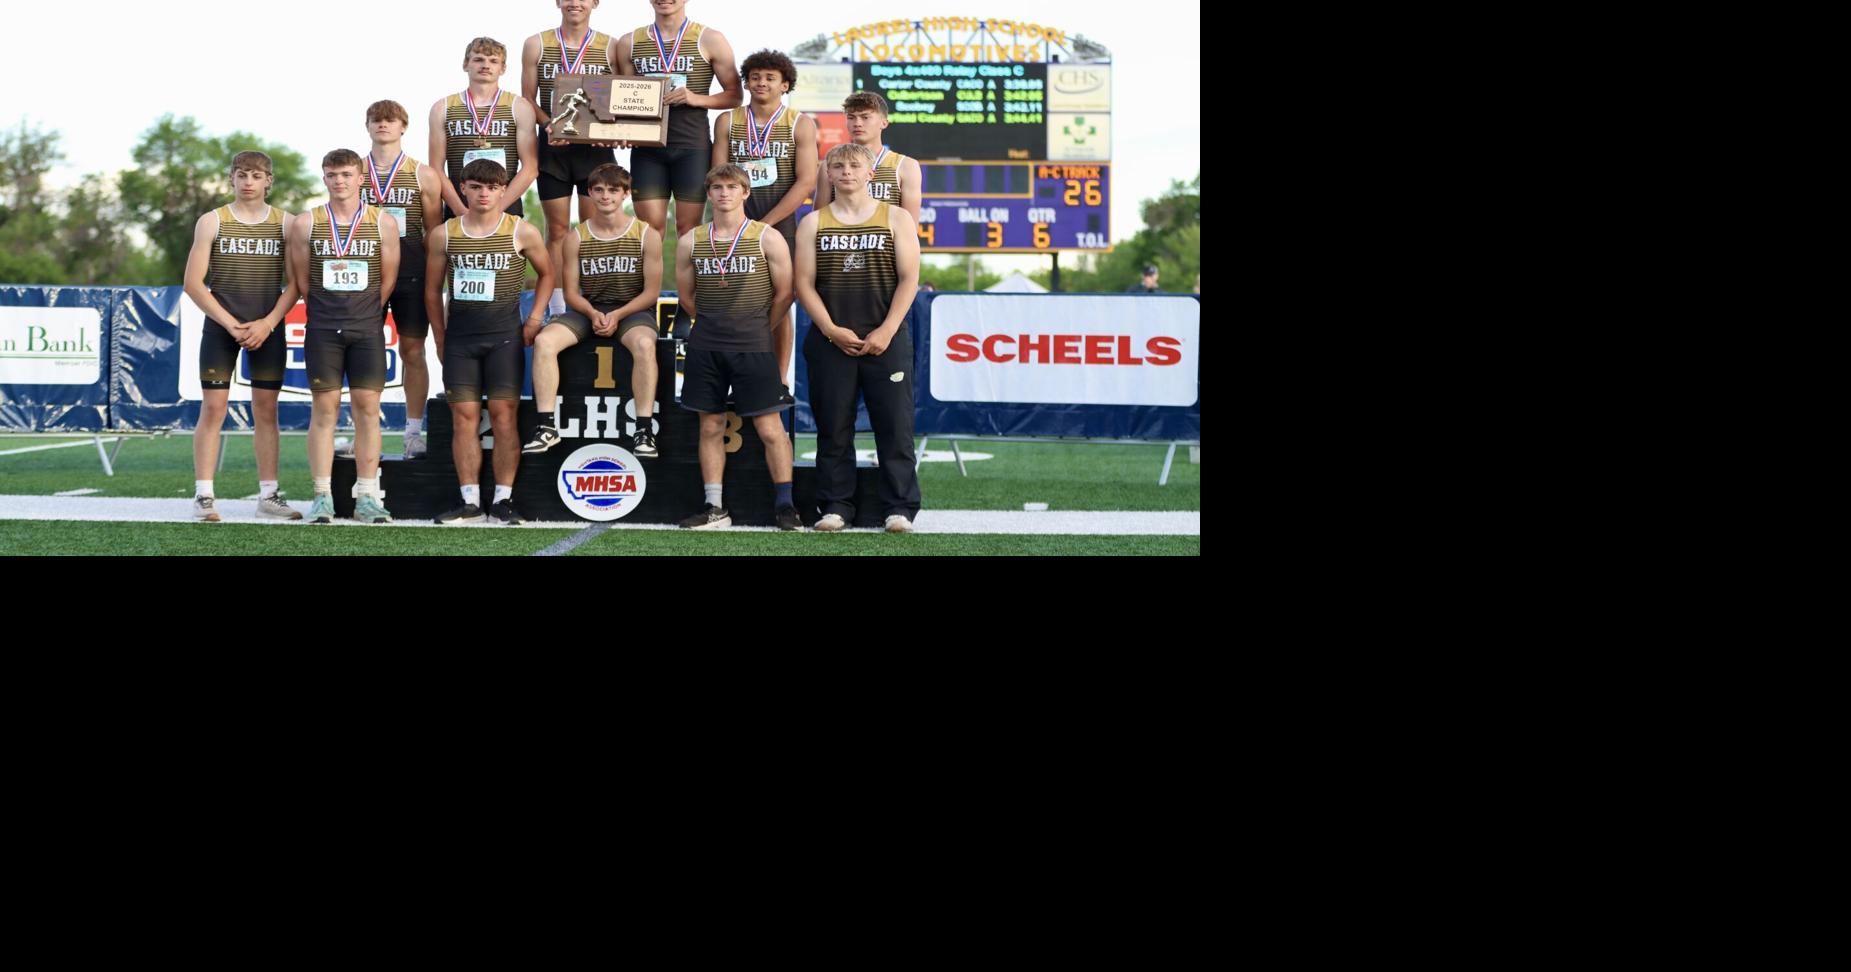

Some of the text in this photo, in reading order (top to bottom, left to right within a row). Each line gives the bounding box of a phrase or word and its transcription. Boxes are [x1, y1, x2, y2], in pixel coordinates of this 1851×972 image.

[833, 16, 1067, 47] LAUREL HIGH SCHOOL
[859, 44, 1040, 62] LOCOMOTIVES
[1013, 65, 1024, 76] C
[1058, 70, 1101, 85] CHS
[986, 79, 996, 90] A
[986, 90, 996, 101] A
[612, 104, 654, 112] CHAMPIONS
[986, 101, 996, 112] A
[986, 112, 996, 124] A
[1062, 166, 1101, 180] TRACK
[1063, 180, 1102, 206] 26
[958, 208, 1009, 223] BALL ON
[1027, 208, 1056, 223] QTR
[820, 235, 886, 250] CASCADE
[986, 223, 1003, 248] 3
[1033, 223, 1050, 248] 6
[219, 238, 280, 256] CASCADE
[581, 256, 638, 276] CASCADE
[333, 272, 359, 284] 193
[460, 280, 485, 294] 200
[27, 326, 94, 352] Bank
[945, 333, 1183, 366] SCHEELS
[594, 347, 616, 388] 1
[575, 474, 637, 493] MHSA
